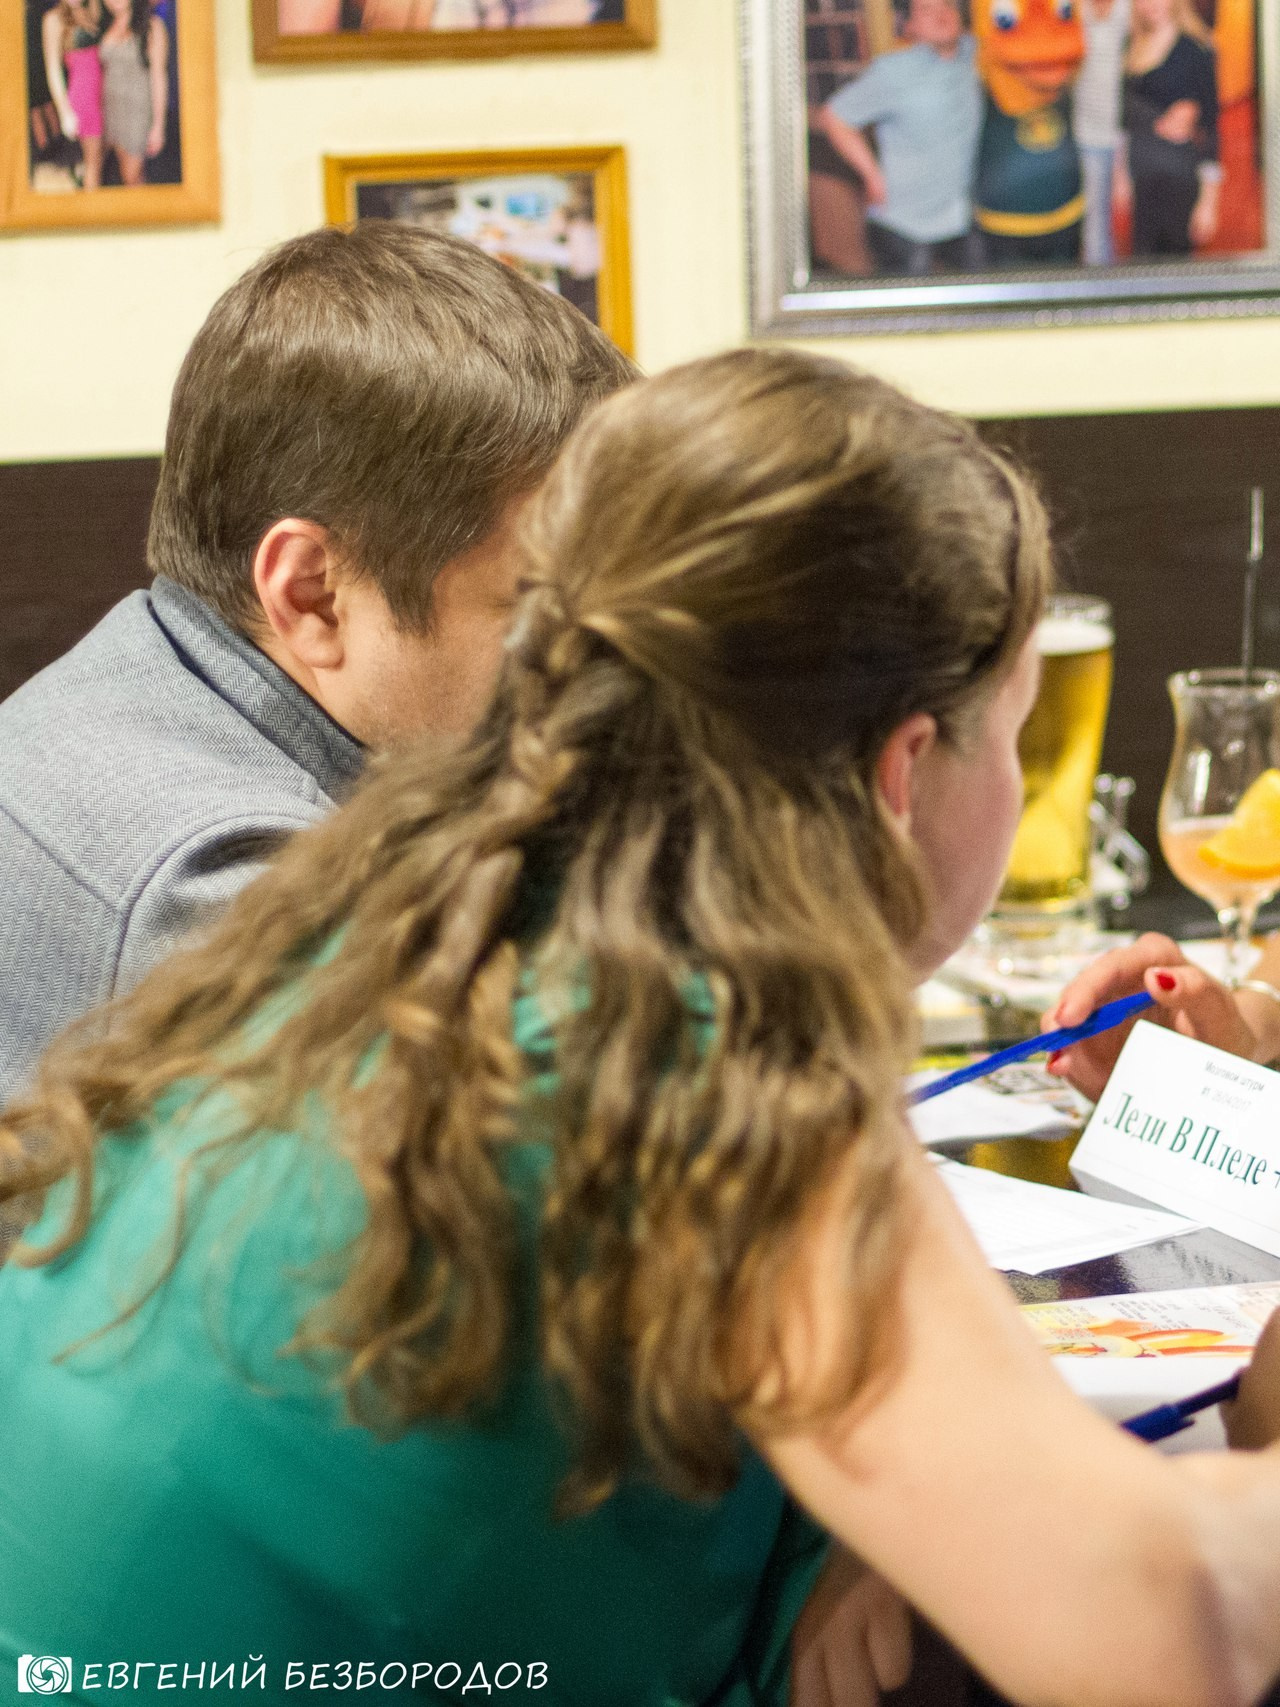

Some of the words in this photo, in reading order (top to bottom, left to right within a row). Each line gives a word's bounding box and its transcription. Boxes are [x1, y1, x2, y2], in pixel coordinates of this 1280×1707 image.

[1103, 1092, 1167, 1143] Леди
[1169, 1116, 1194, 1153] В
[1192, 1125, 1267, 1185] Пледе
